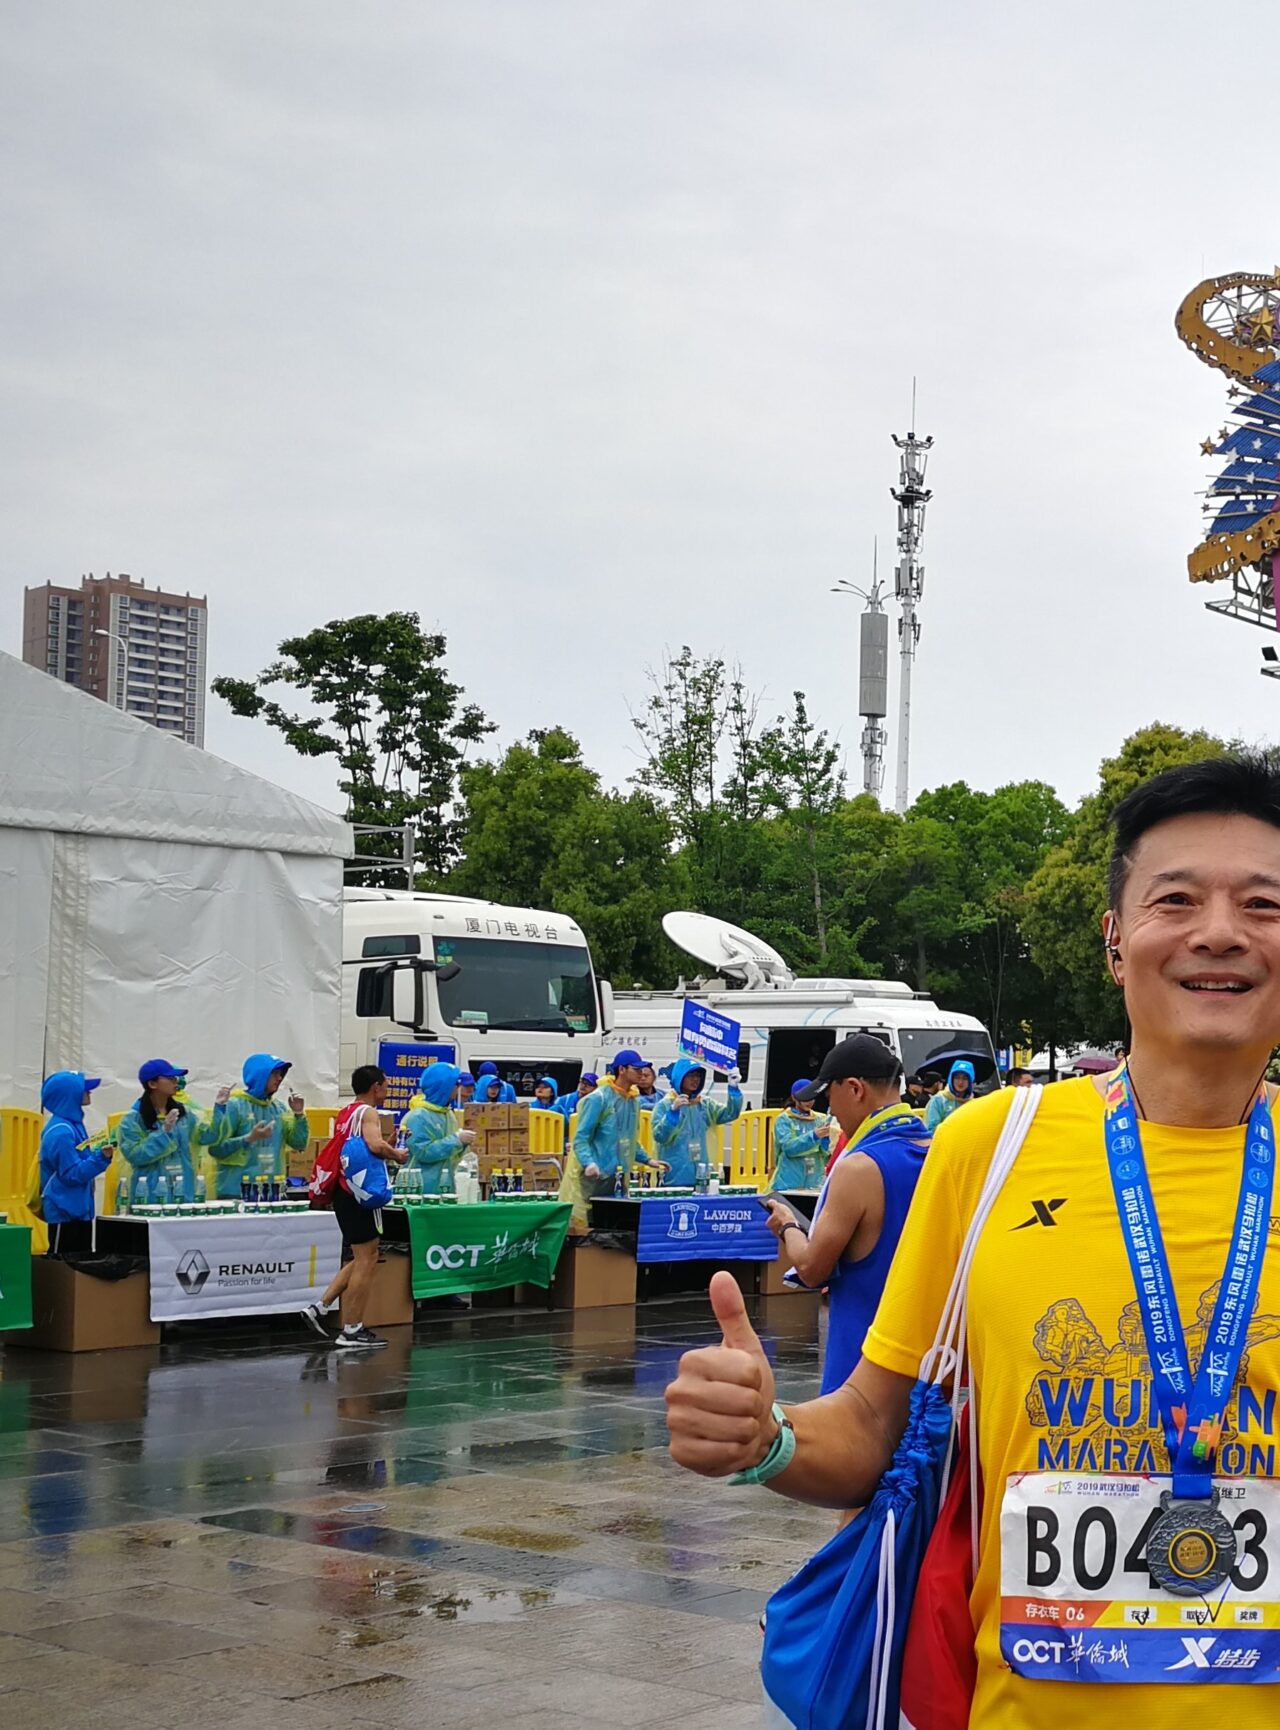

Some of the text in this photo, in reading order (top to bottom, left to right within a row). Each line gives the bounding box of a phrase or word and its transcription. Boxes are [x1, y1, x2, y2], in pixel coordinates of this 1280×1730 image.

[465, 917, 558, 940] 厦门电视台
[703, 1209, 752, 1221] LAWSON
[1136, 1185, 1150, 1225] MARATHON
[1146, 1226, 1158, 1254] WUHAN
[218, 1261, 296, 1277] RENAULT
[426, 1243, 486, 1270] OCT
[1121, 1186, 1167, 1344] 2019东风雷诺武汉马拉松
[1215, 1191, 1259, 1345] 2019东风雷诺武汉马拉松
[218, 1276, 276, 1287] Passion for life
[1154, 1258, 1166, 1295] RENAULT
[1228, 1196, 1265, 1347] DONGFENG RENAULT WUHAN MARATHON
[1161, 1298, 1176, 1342] DONGFENG
[1038, 1378, 1277, 1435] WUN
[1038, 1437, 1275, 1476] MARAON
[1076, 1482, 1140, 1492] 2019武汉马拉松
[1026, 1505, 1269, 1592] B043
[1025, 1603, 1085, 1621] 存衣车 06
[1240, 1610, 1258, 1621] 奖牌
[1013, 1638, 1066, 1664] OCT
[1211, 1648, 1261, 1668] 特步
